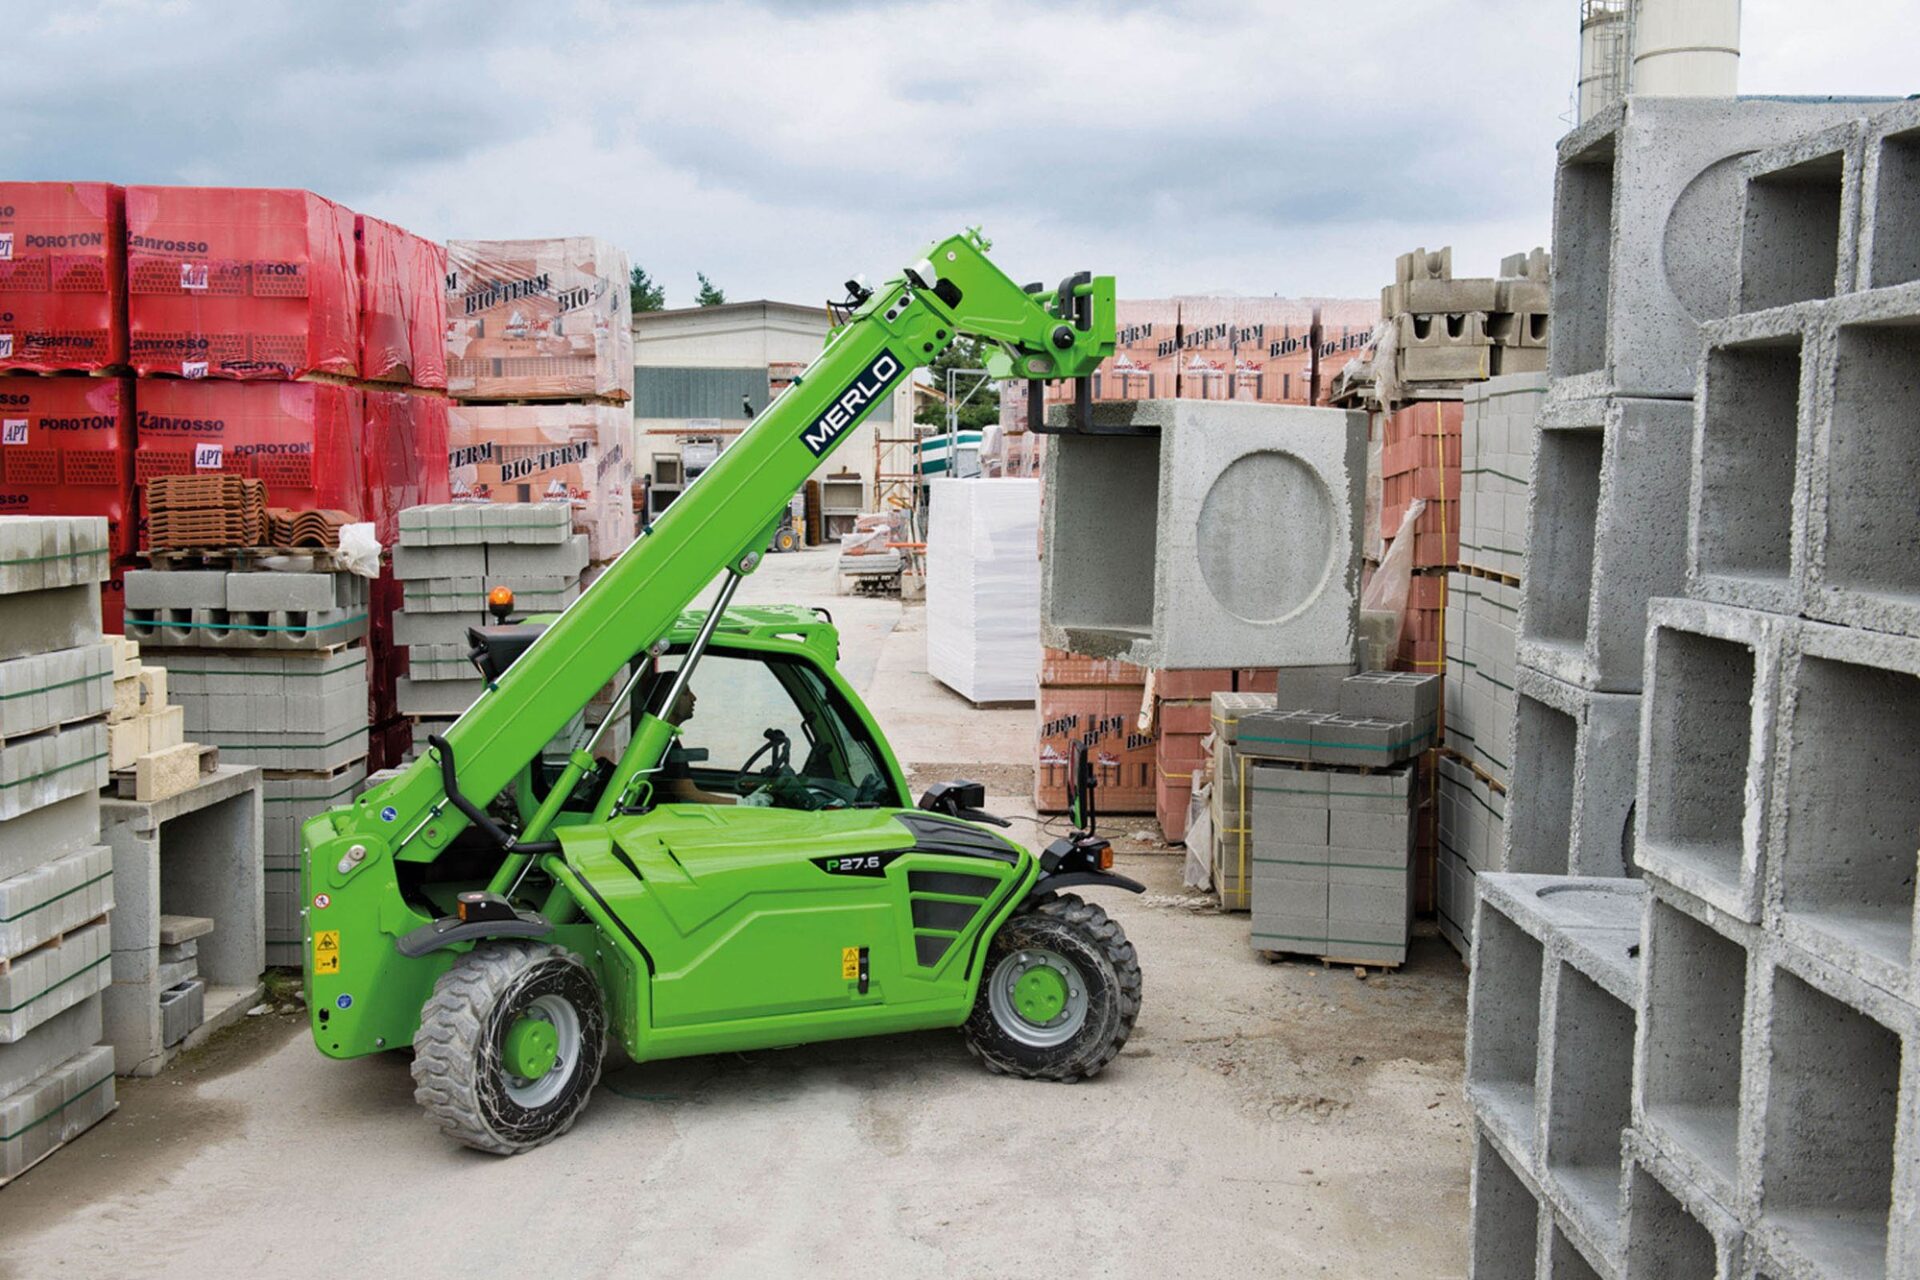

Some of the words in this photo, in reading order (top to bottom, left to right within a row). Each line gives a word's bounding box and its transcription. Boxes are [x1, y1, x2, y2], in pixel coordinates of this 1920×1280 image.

[25, 232, 102, 248] POROTON
[465, 273, 549, 314] BIO-TERM
[133, 338, 208, 351] anrosso
[805, 355, 897, 452] MERLO
[39, 416, 115, 431] POROTON
[137, 410, 224, 431] Zanrosso
[5, 425, 27, 441] APT
[197, 449, 221, 465] APT
[234, 443, 311, 457] POROTON
[501, 441, 588, 482] BIO-TERM
[827, 856, 880, 872] P27.6
